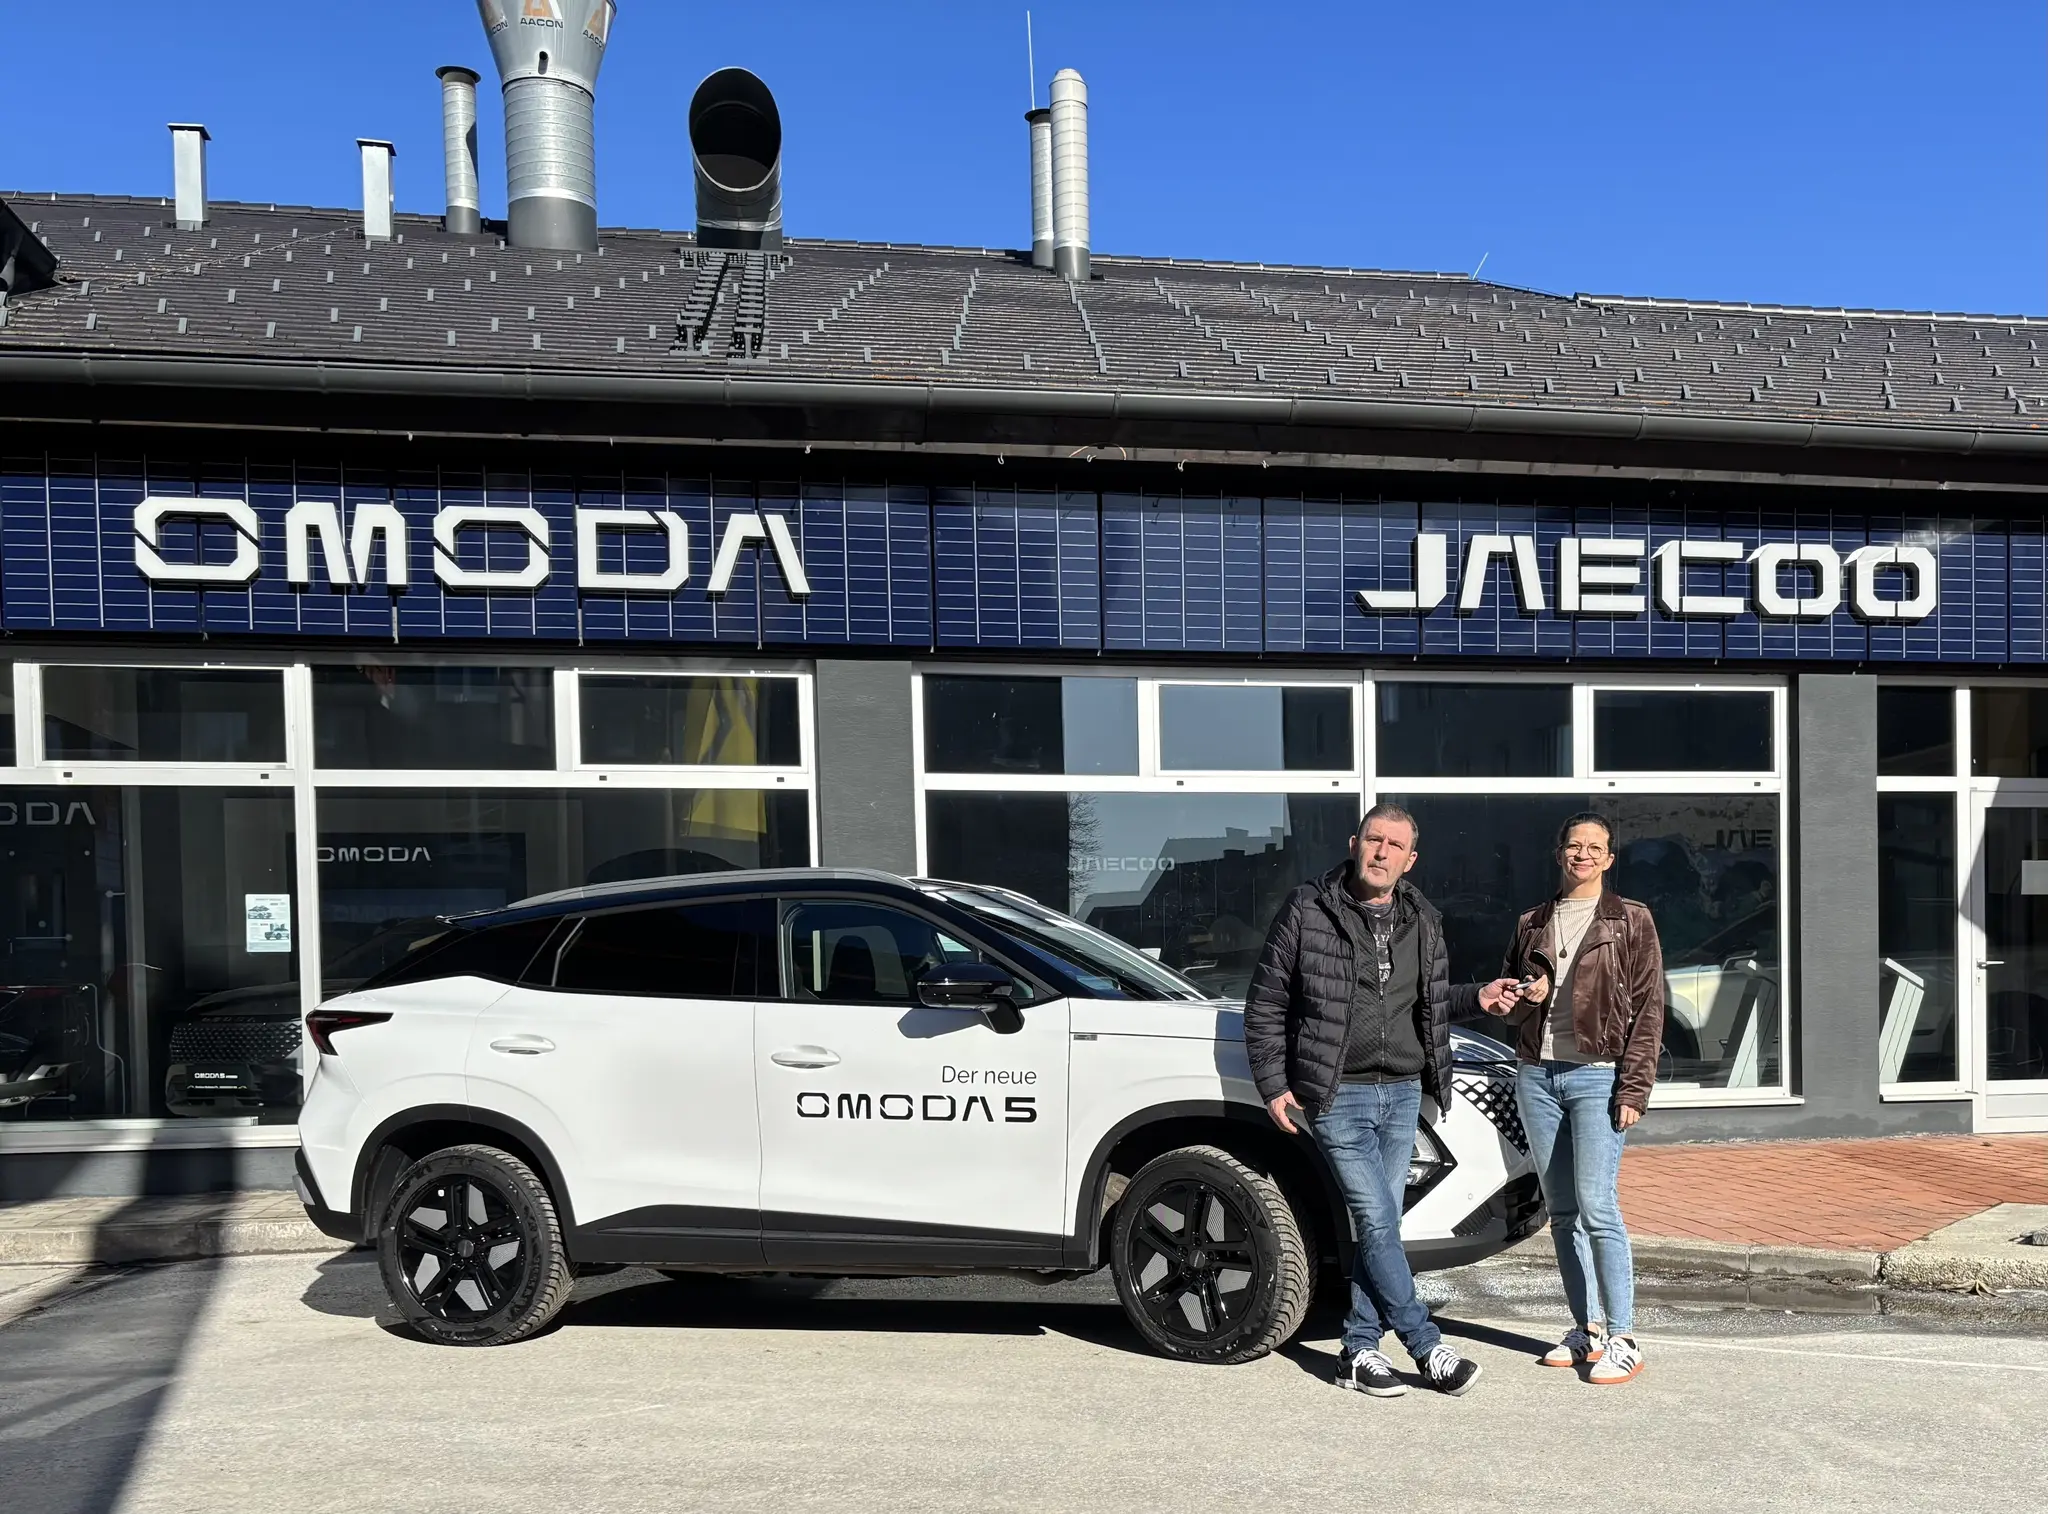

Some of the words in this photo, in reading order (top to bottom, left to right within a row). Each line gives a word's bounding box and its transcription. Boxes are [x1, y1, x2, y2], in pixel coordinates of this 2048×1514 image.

[520, 17, 563, 28] AACON
[133, 496, 812, 596] OMODA
[1357, 534, 1937, 618] JAECOO
[317, 847, 431, 862] OMODA
[1067, 857, 1175, 871] JAECOO
[941, 1065, 978, 1084] Der
[984, 1070, 1037, 1085] neue
